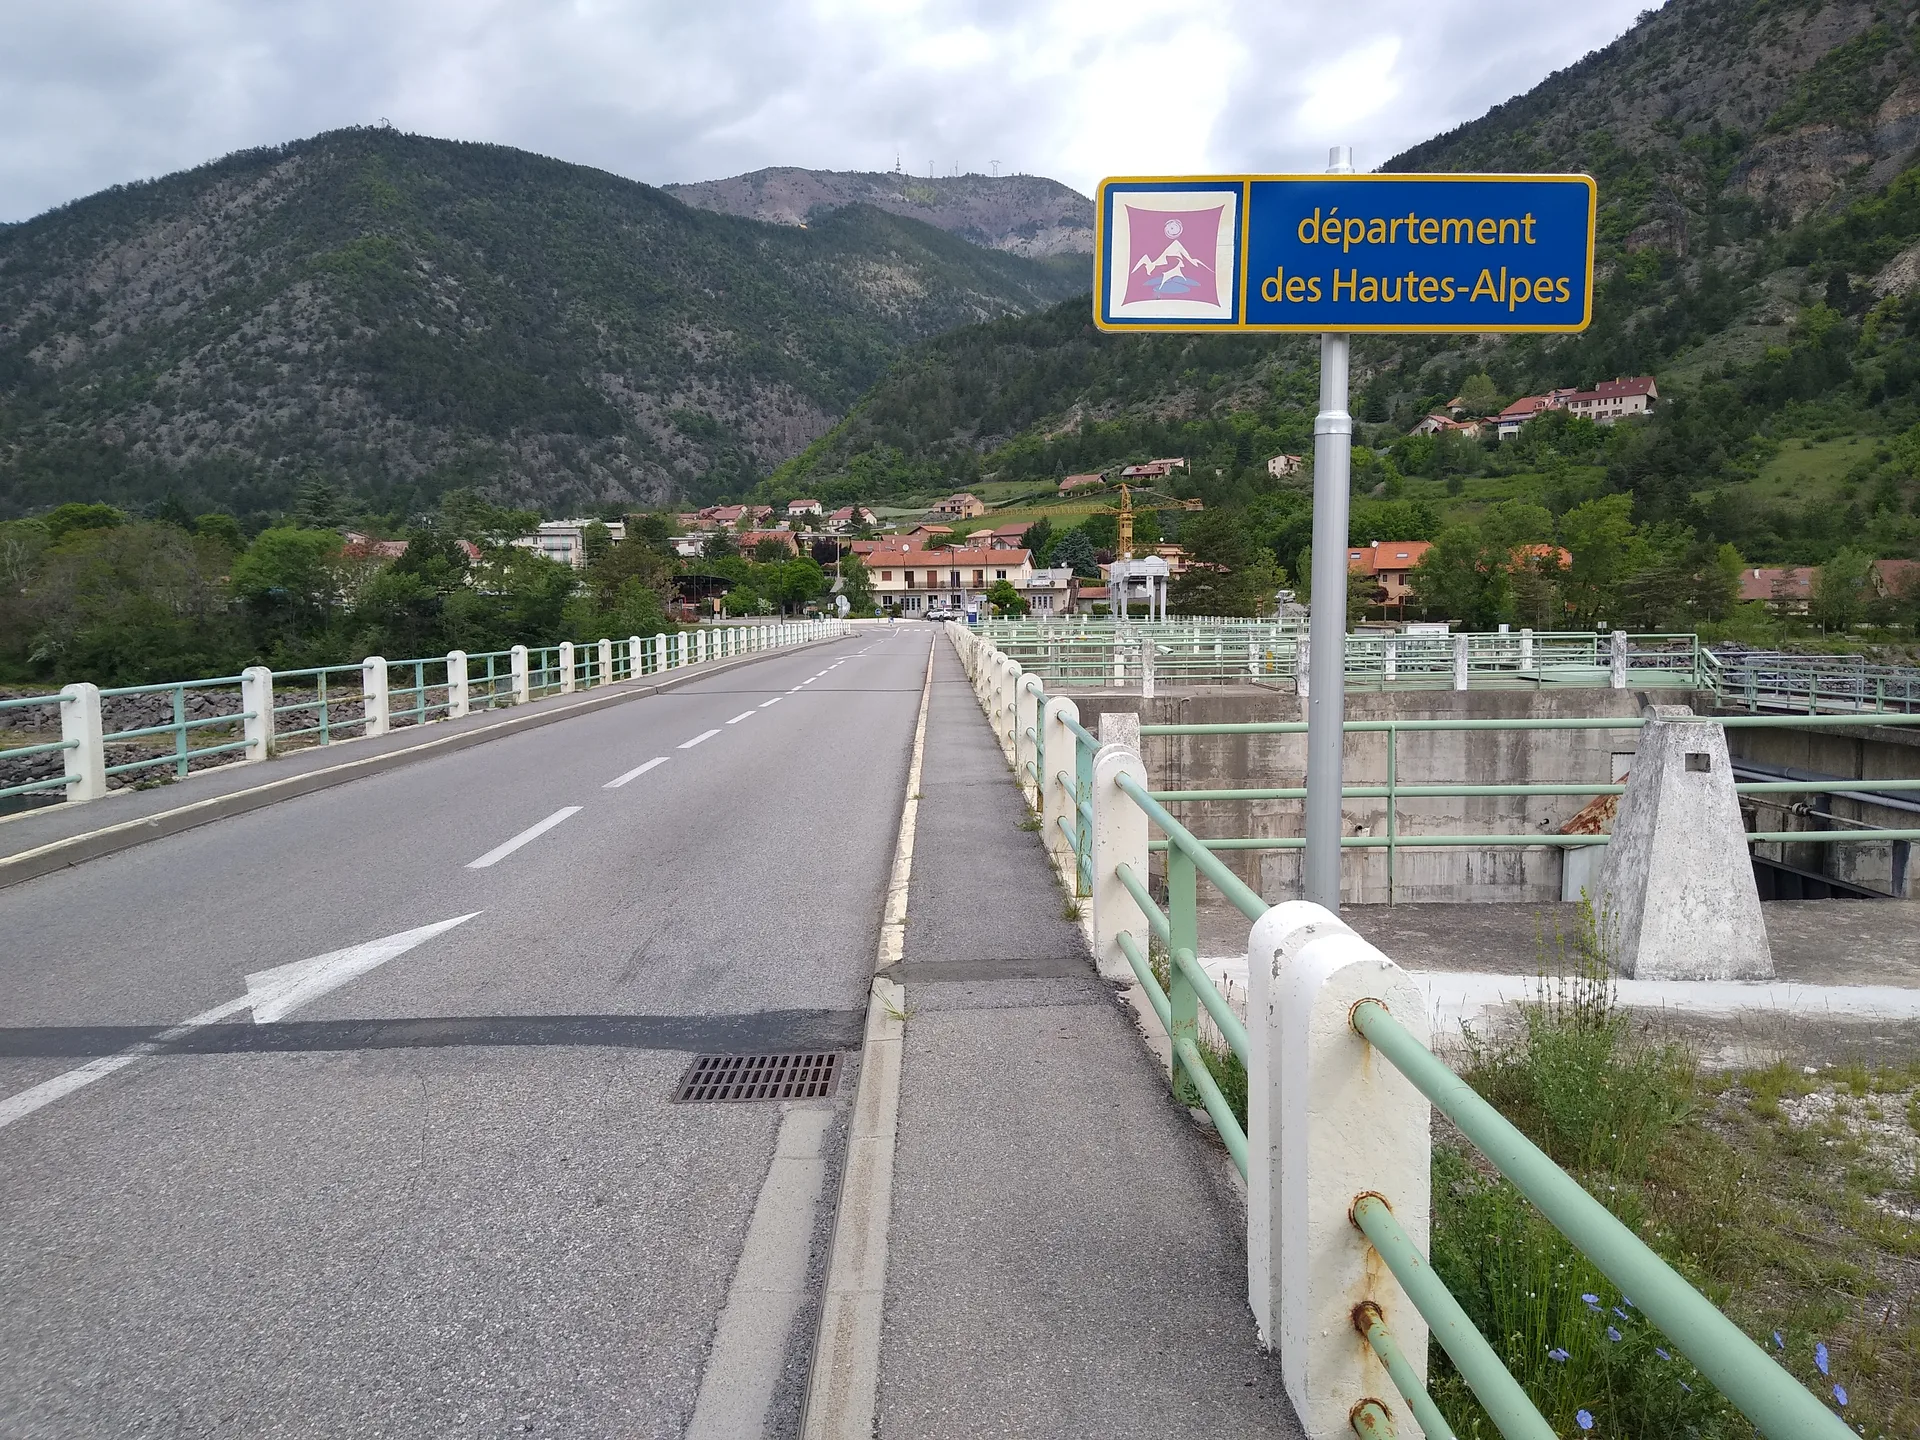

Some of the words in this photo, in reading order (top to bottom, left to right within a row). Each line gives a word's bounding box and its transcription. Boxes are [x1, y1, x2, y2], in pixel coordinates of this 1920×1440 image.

[1297, 207, 1536, 253] département
[1261, 266, 1322, 303] des
[1332, 266, 1570, 312] Hautes-Alpes
